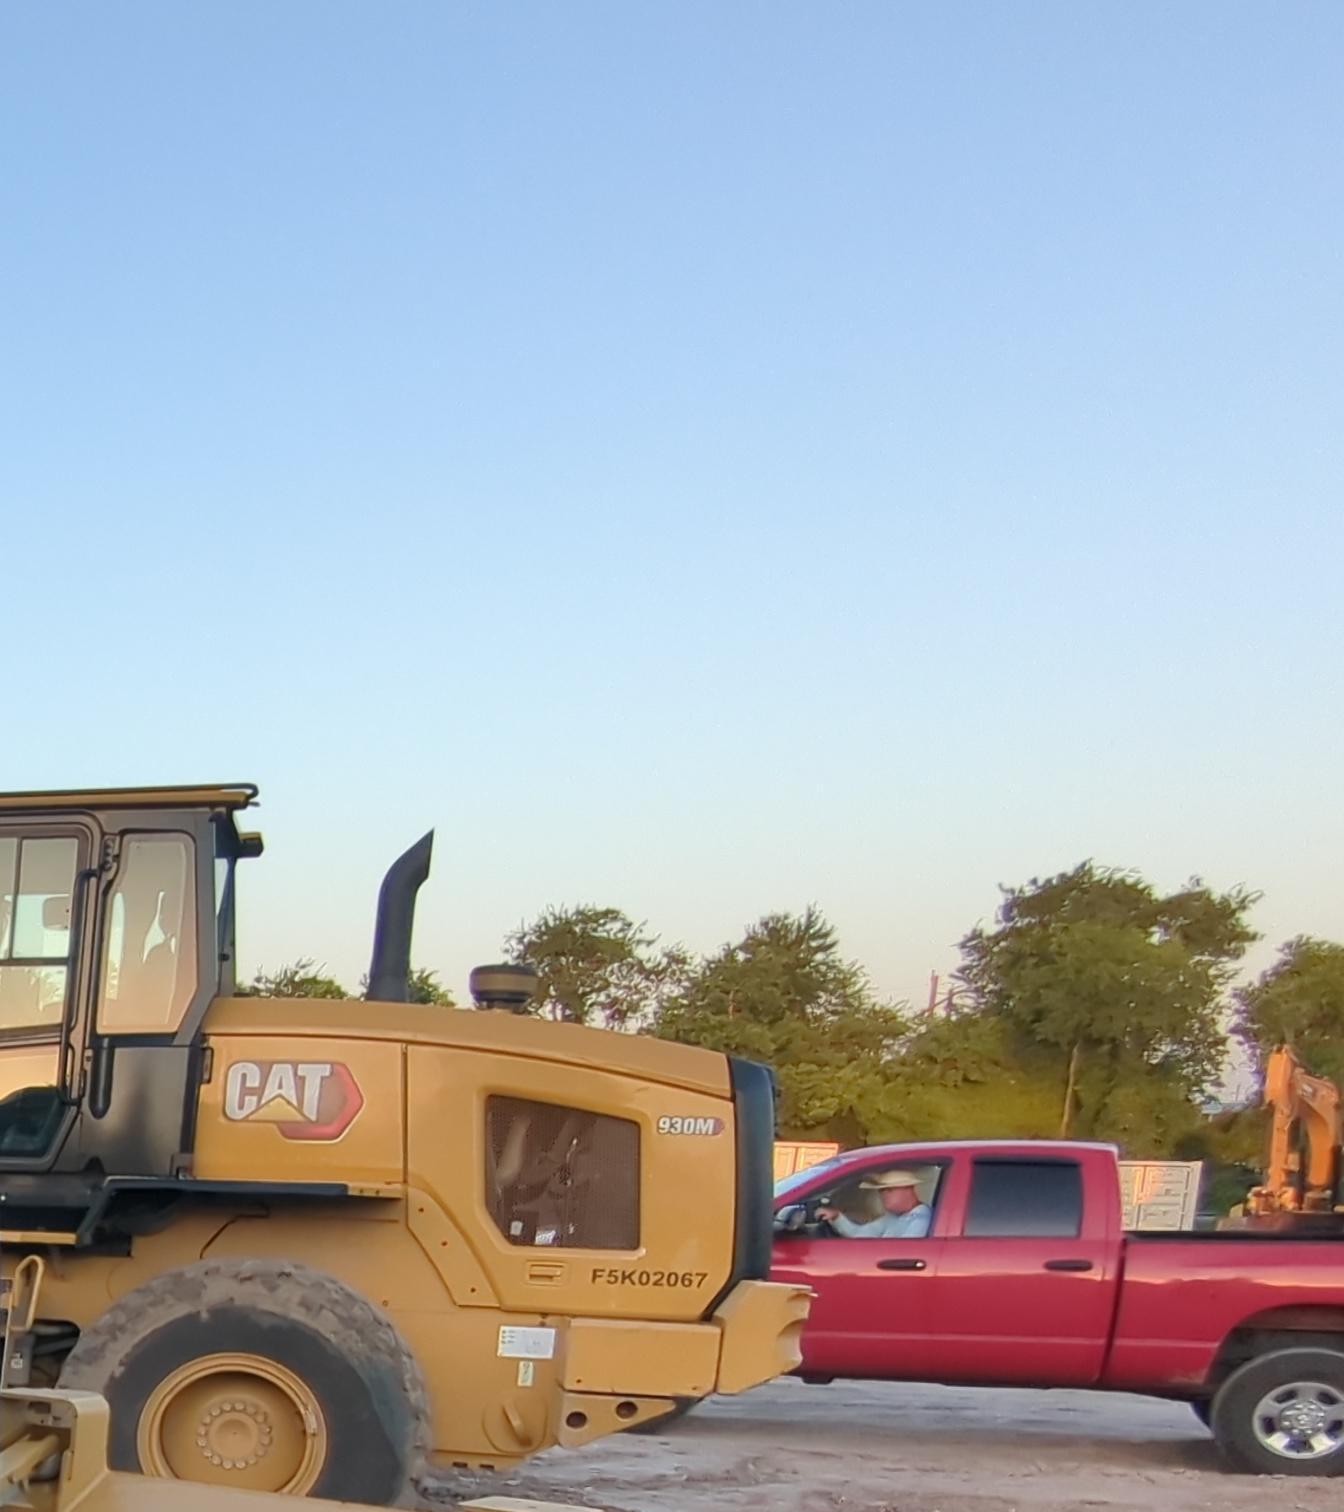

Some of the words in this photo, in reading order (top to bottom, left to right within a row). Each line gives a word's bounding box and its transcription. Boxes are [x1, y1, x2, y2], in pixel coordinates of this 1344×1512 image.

[224, 1061, 333, 1121] CAT
[658, 1116, 716, 1136] 930M
[591, 1268, 708, 1288] F5K02067
